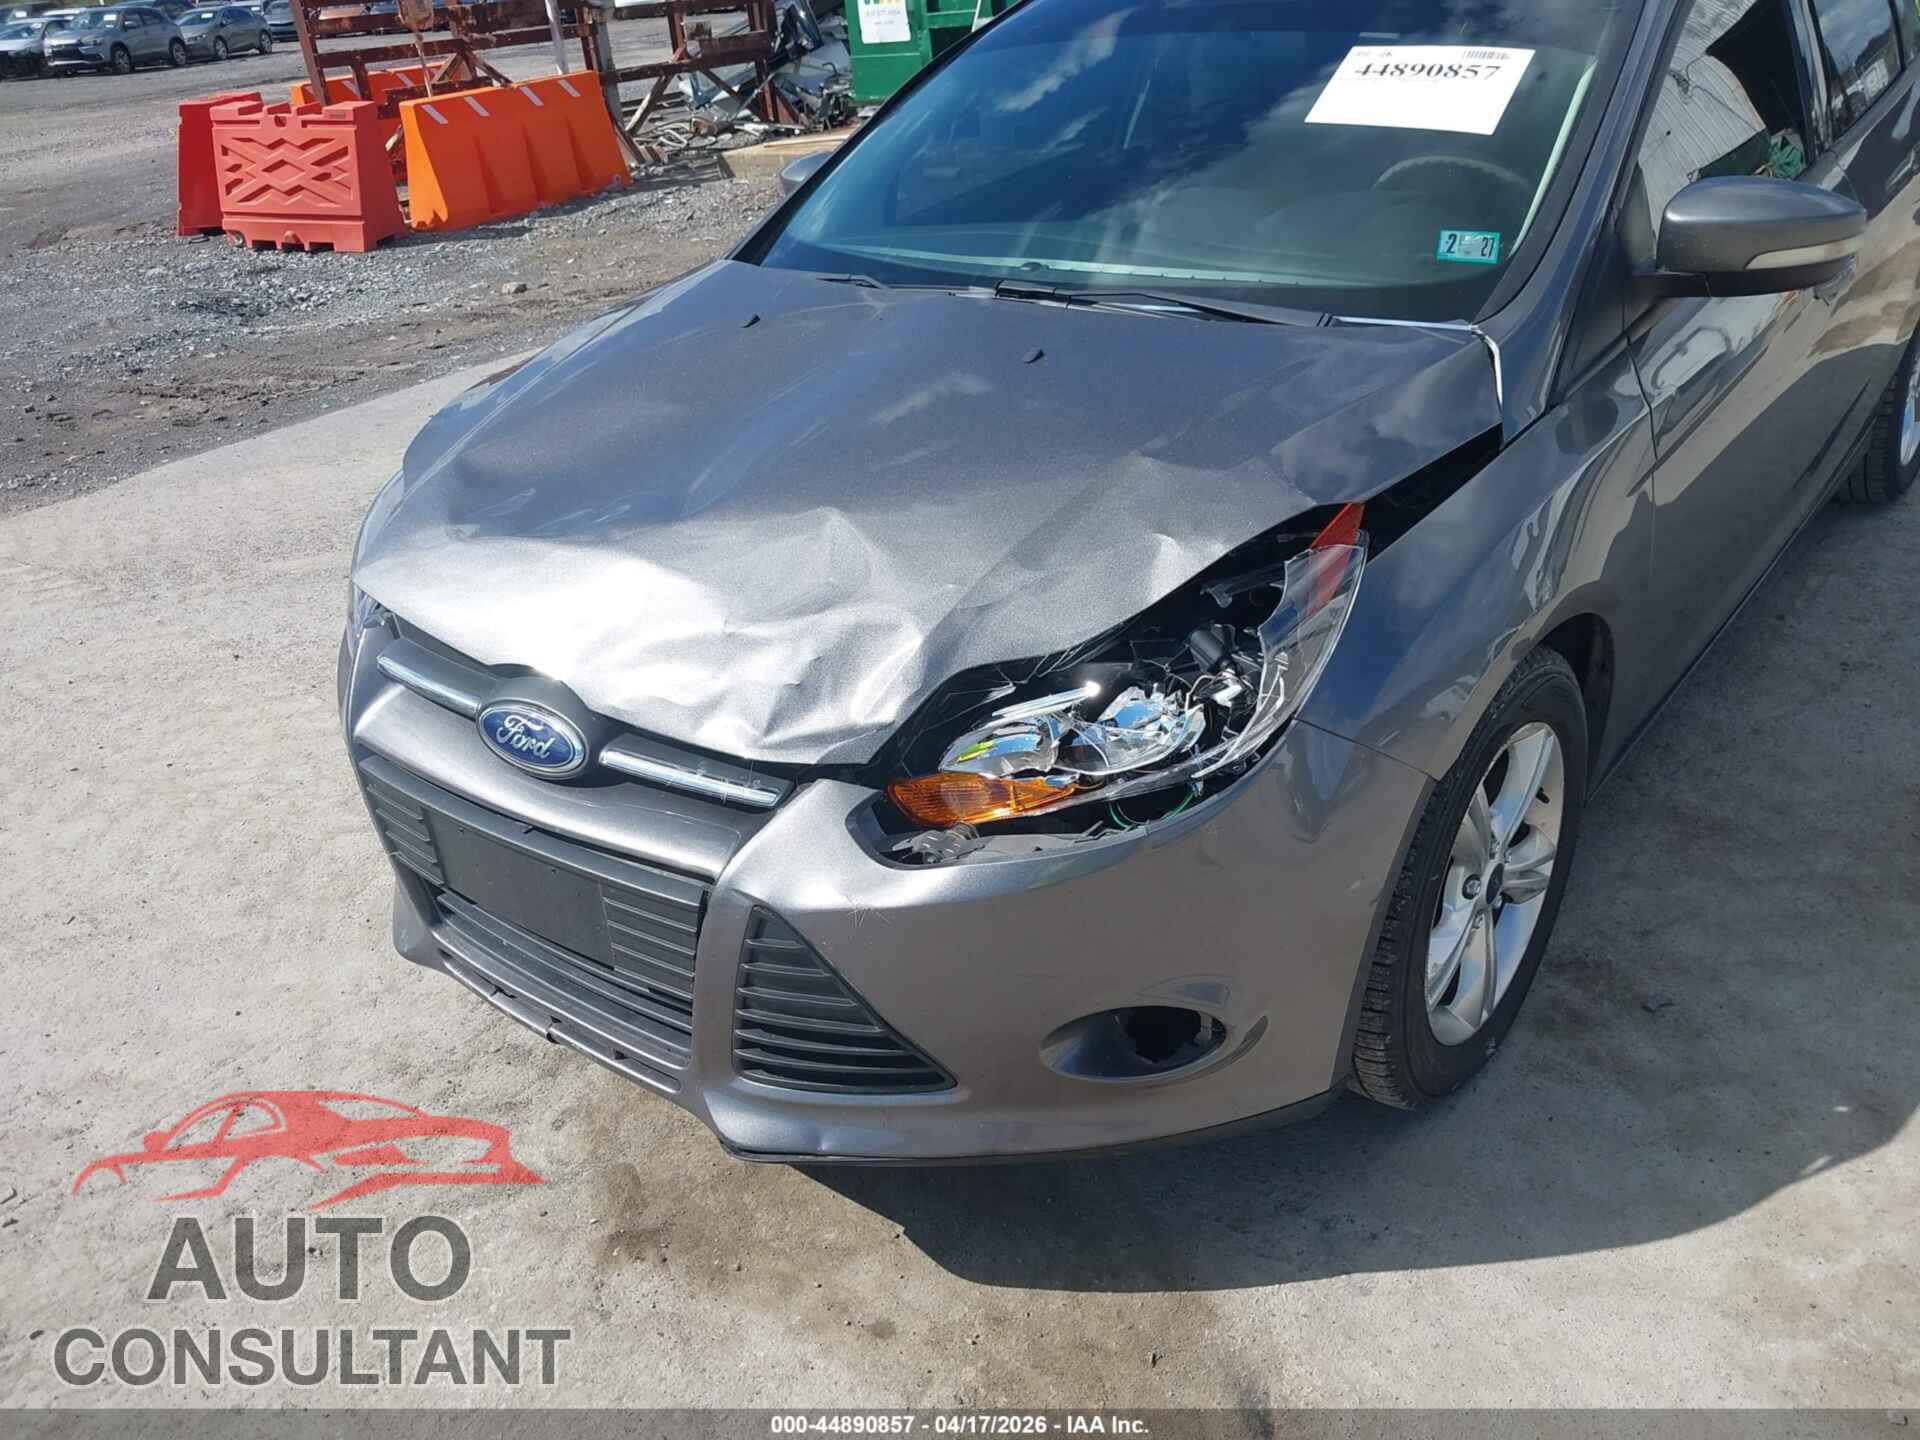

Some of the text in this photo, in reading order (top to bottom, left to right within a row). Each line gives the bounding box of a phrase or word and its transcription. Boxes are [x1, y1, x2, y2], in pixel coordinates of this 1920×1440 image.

[1355, 63, 1502, 80] 44890857
[1481, 236, 1496, 257] 27
[496, 714, 556, 759] Ford
